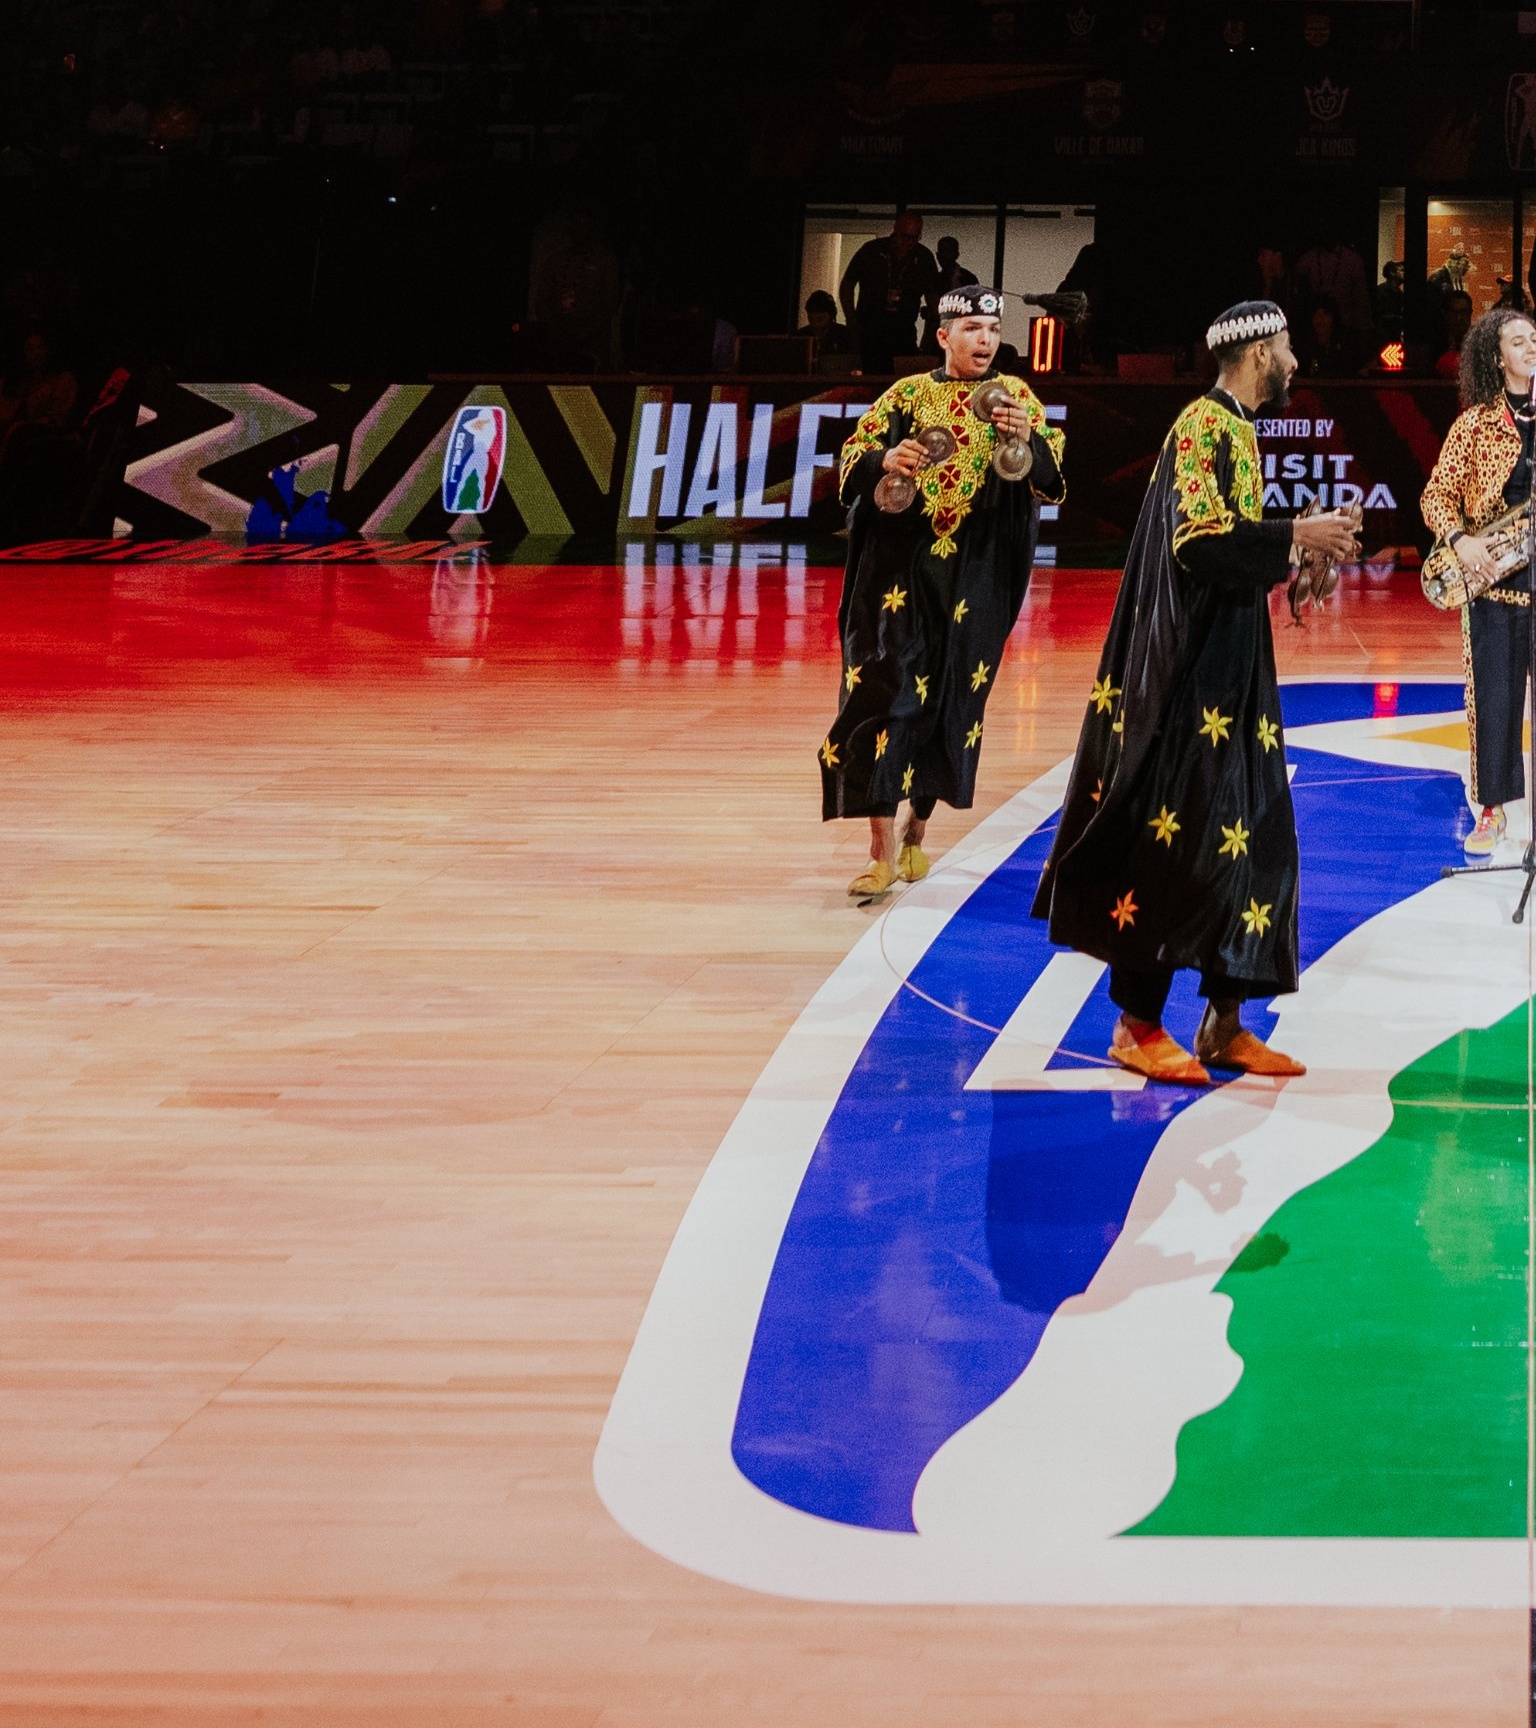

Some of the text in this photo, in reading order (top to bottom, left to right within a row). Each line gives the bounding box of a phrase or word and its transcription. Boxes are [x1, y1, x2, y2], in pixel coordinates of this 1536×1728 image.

[1253, 418, 1335, 438] ESENTED BY
[449, 432, 466, 483] BAL
[1259, 453, 1355, 480] ISIT
[1262, 482, 1398, 509] ANDA
